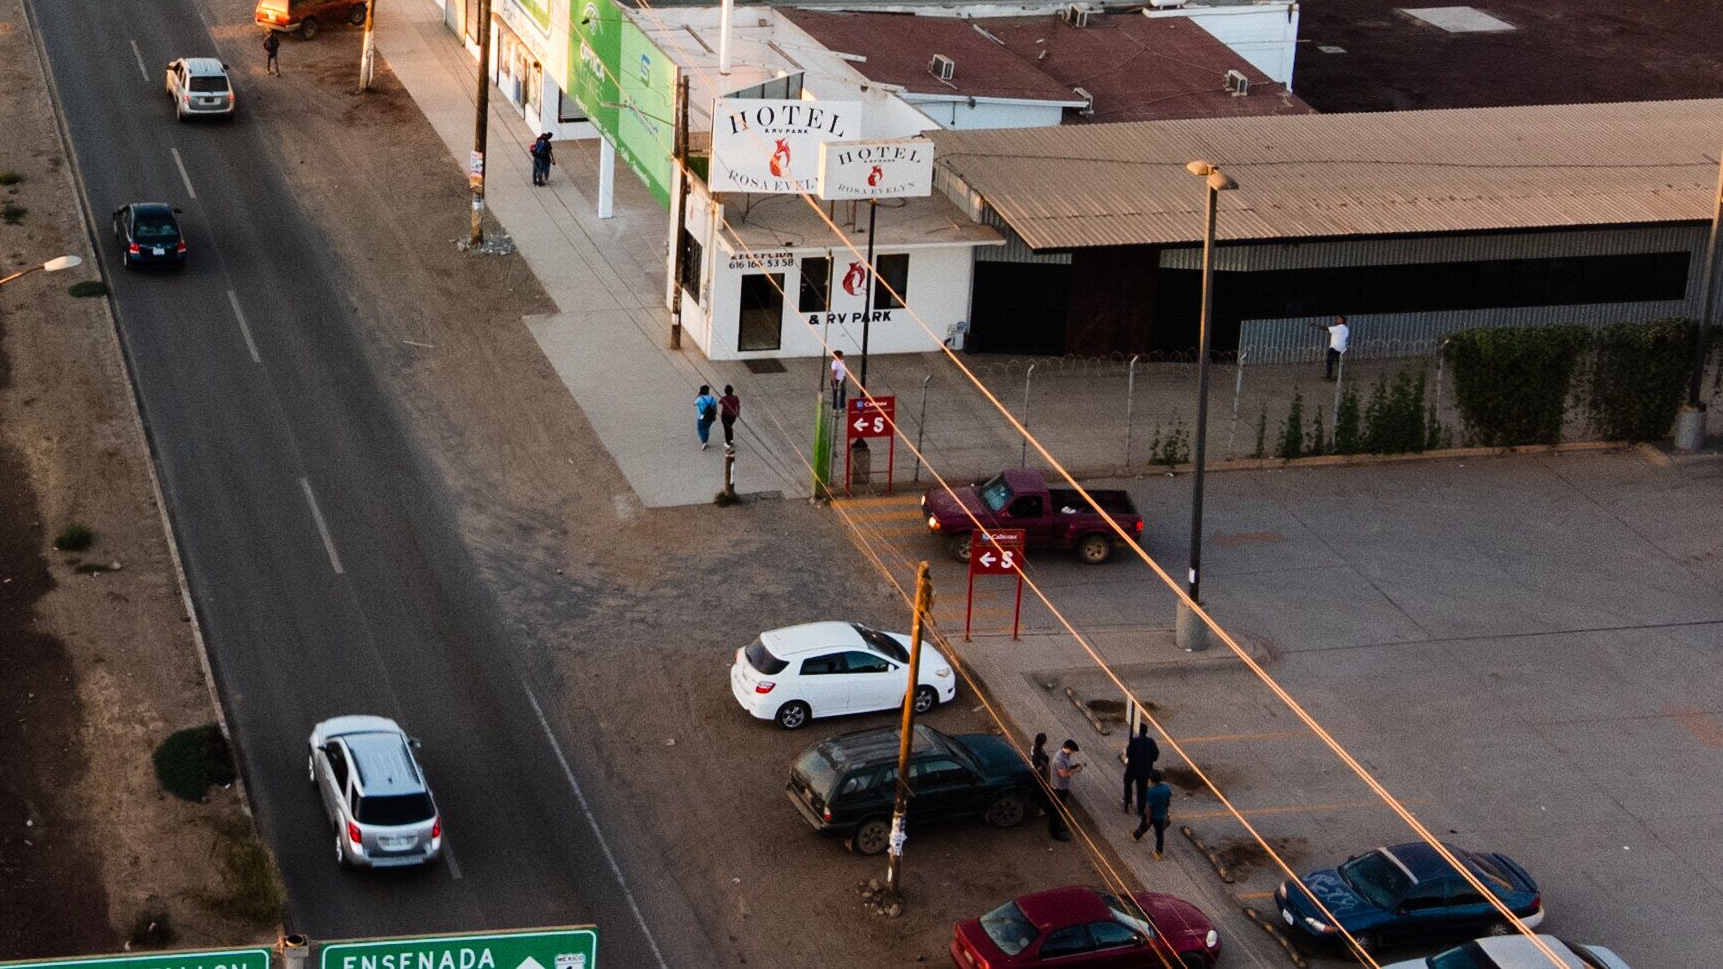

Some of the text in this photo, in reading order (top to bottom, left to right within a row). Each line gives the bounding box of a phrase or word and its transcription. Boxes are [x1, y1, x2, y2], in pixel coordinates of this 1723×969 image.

[729, 105, 846, 138] HOTEL
[839, 146, 921, 166] HOTEL
[728, 169, 819, 192] ROSA EVEL
[838, 181, 915, 195] ROSA EVELYN
[728, 260, 745, 270] 616
[767, 259, 779, 268] 53
[781, 258, 794, 267] 58
[808, 310, 892, 325] & RV PARK
[873, 416, 884, 433] S
[1000, 550, 1013, 569] S
[343, 948, 496, 969] ENSENADA
